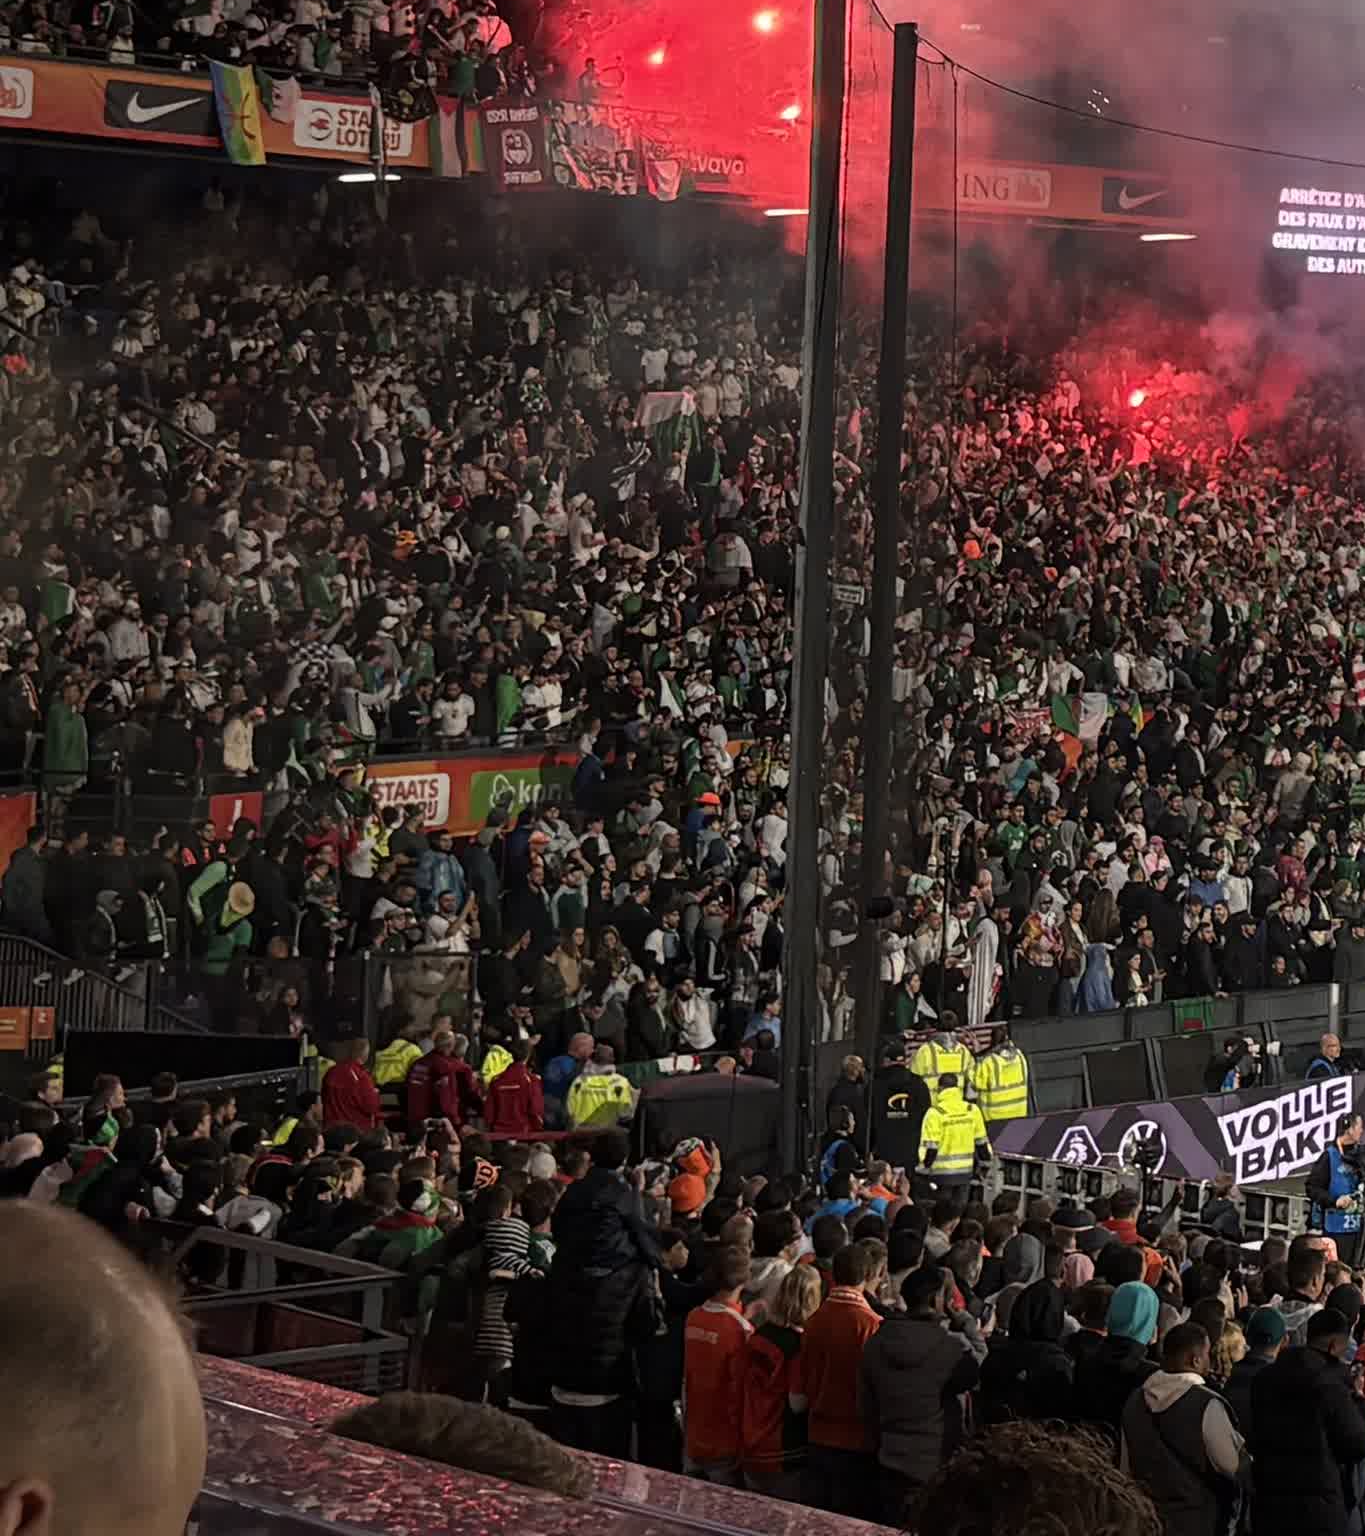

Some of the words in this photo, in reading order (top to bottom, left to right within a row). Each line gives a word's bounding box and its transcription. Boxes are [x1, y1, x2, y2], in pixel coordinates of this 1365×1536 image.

[960, 173, 1009, 200] ING
[1278, 209, 1306, 227] DES
[1308, 212, 1345, 230] FEUX
[1272, 232, 1356, 252] GRAVEMENT
[1307, 256, 1335, 273] DES
[373, 778, 440, 801] STAATS
[1225, 1081, 1348, 1149] VOLLE
